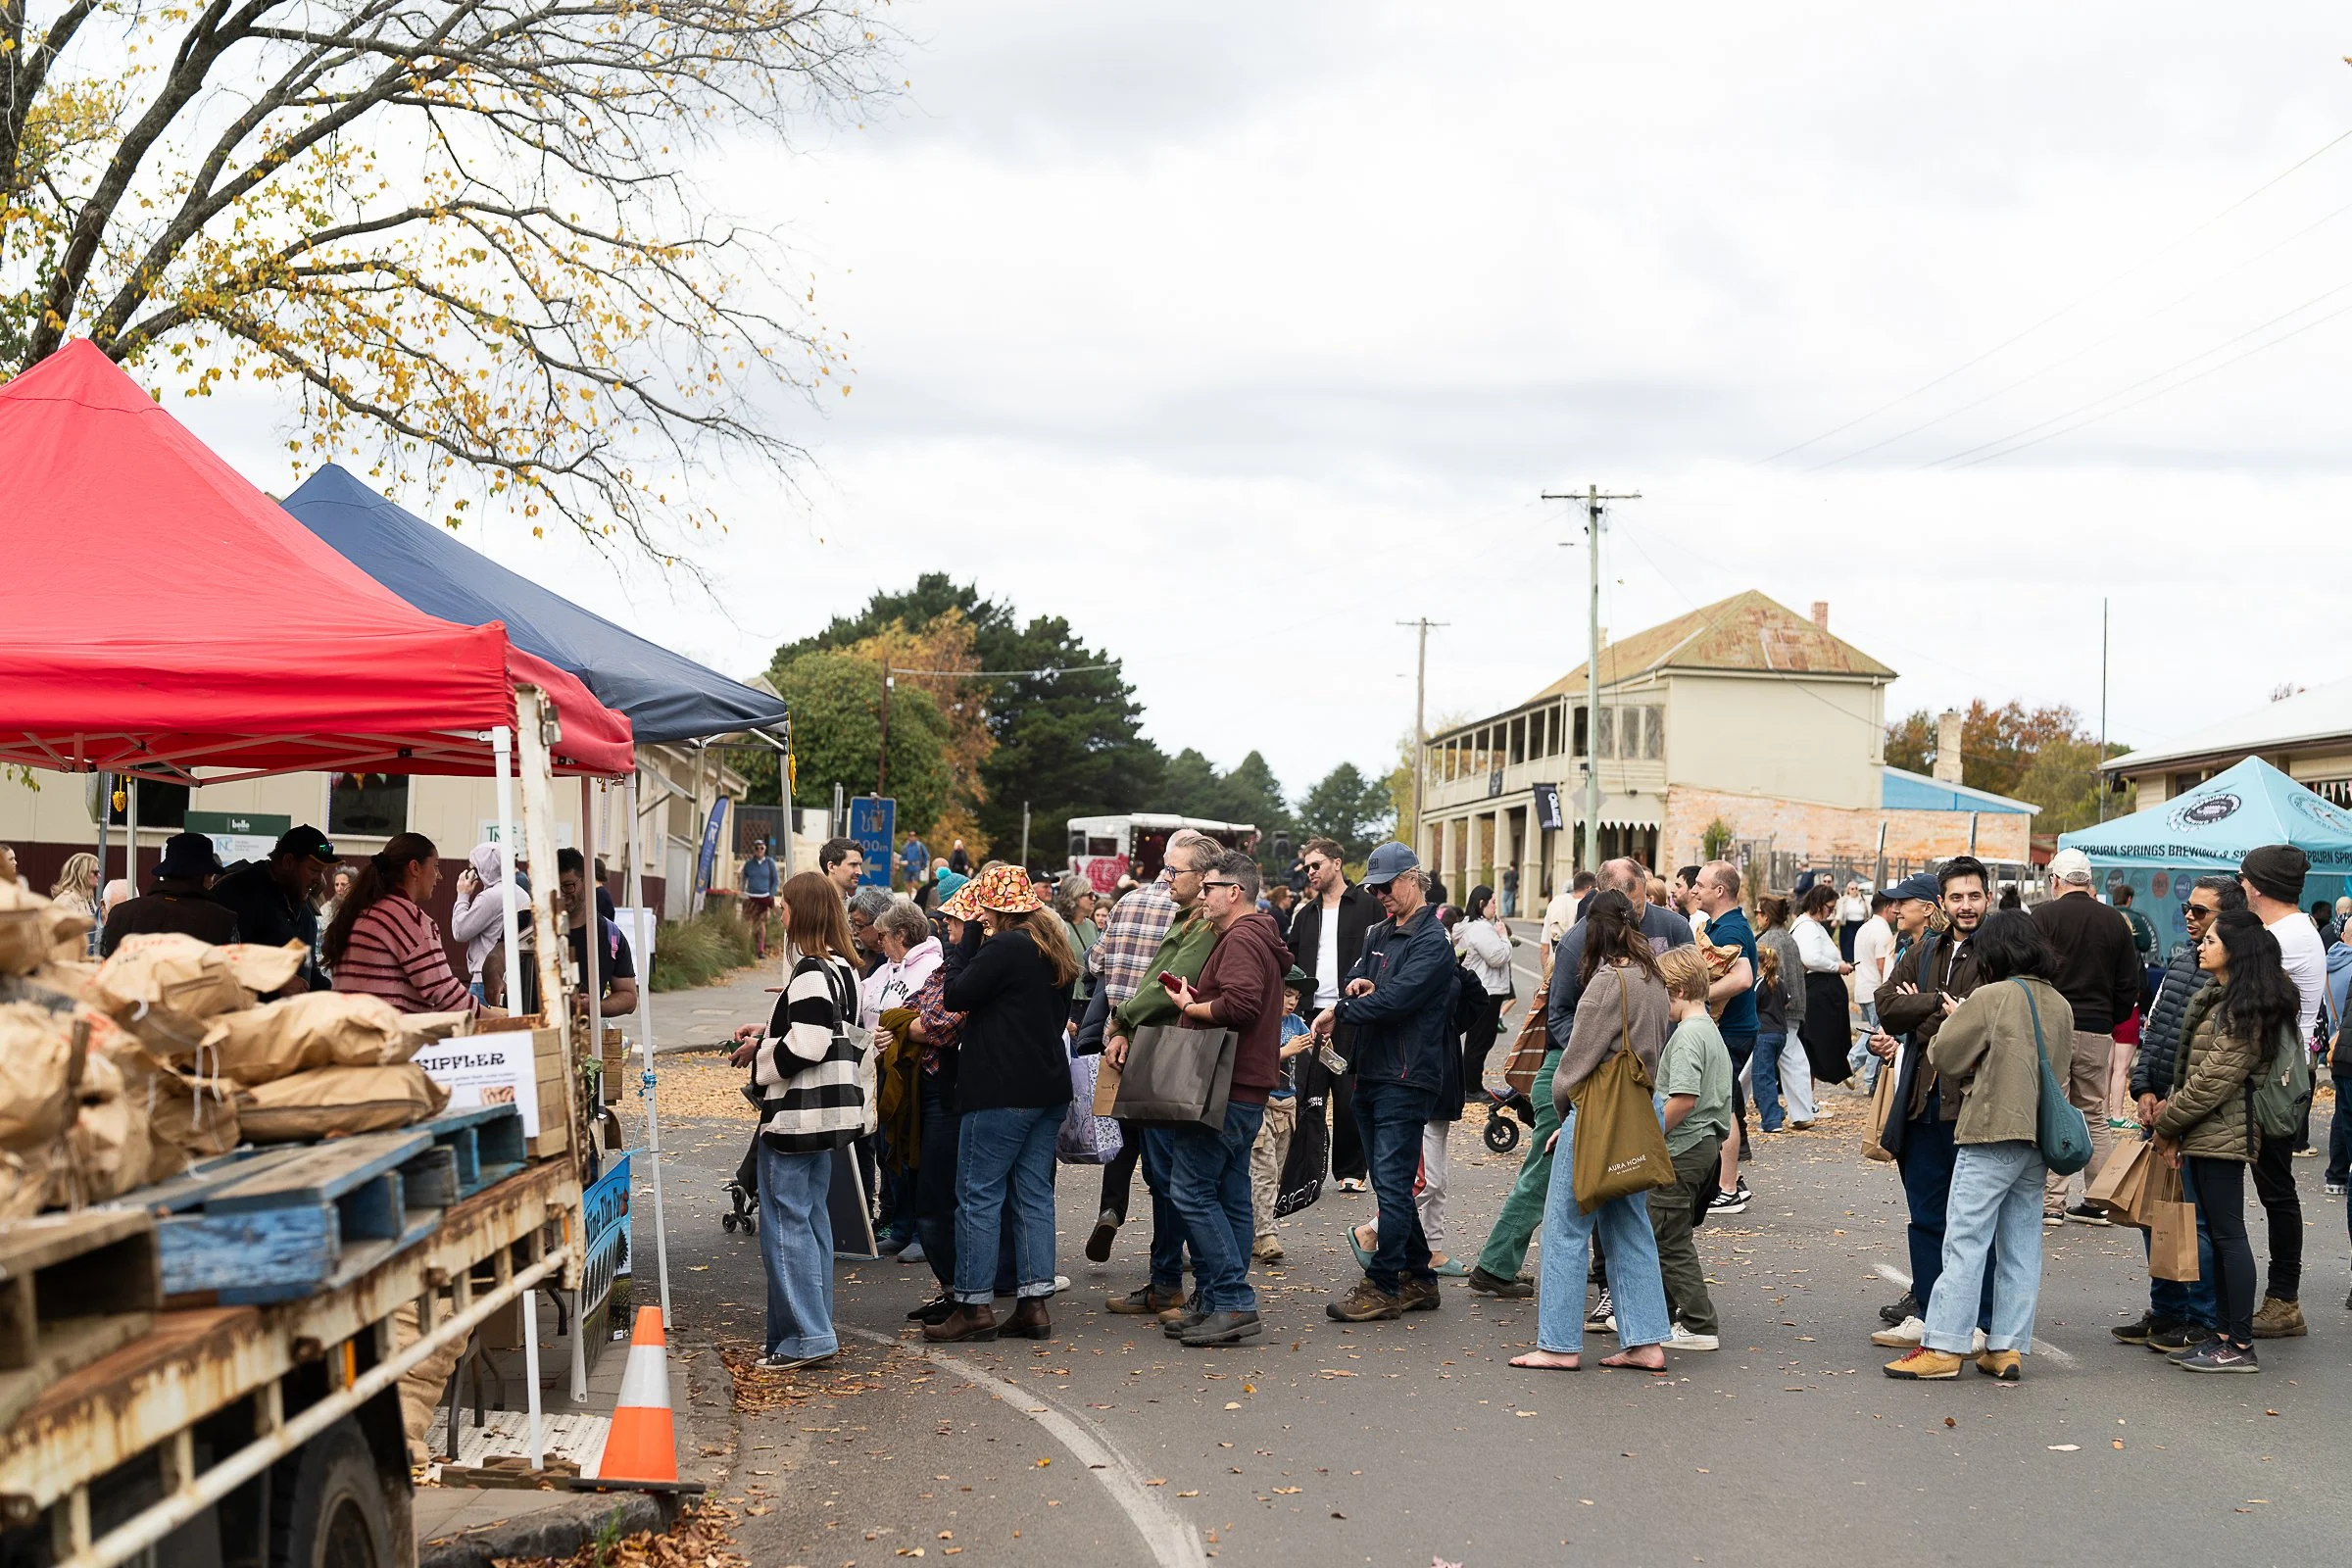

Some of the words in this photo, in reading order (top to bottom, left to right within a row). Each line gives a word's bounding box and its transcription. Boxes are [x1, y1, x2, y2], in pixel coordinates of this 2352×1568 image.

[2120, 845, 2165, 857] SPRINGS
[2306, 851, 2333, 863] PBURN
[1607, 1162, 1627, 1173] AURA
[1627, 1153, 1646, 1166] HOME
[585, 1208, 600, 1250] Nine
